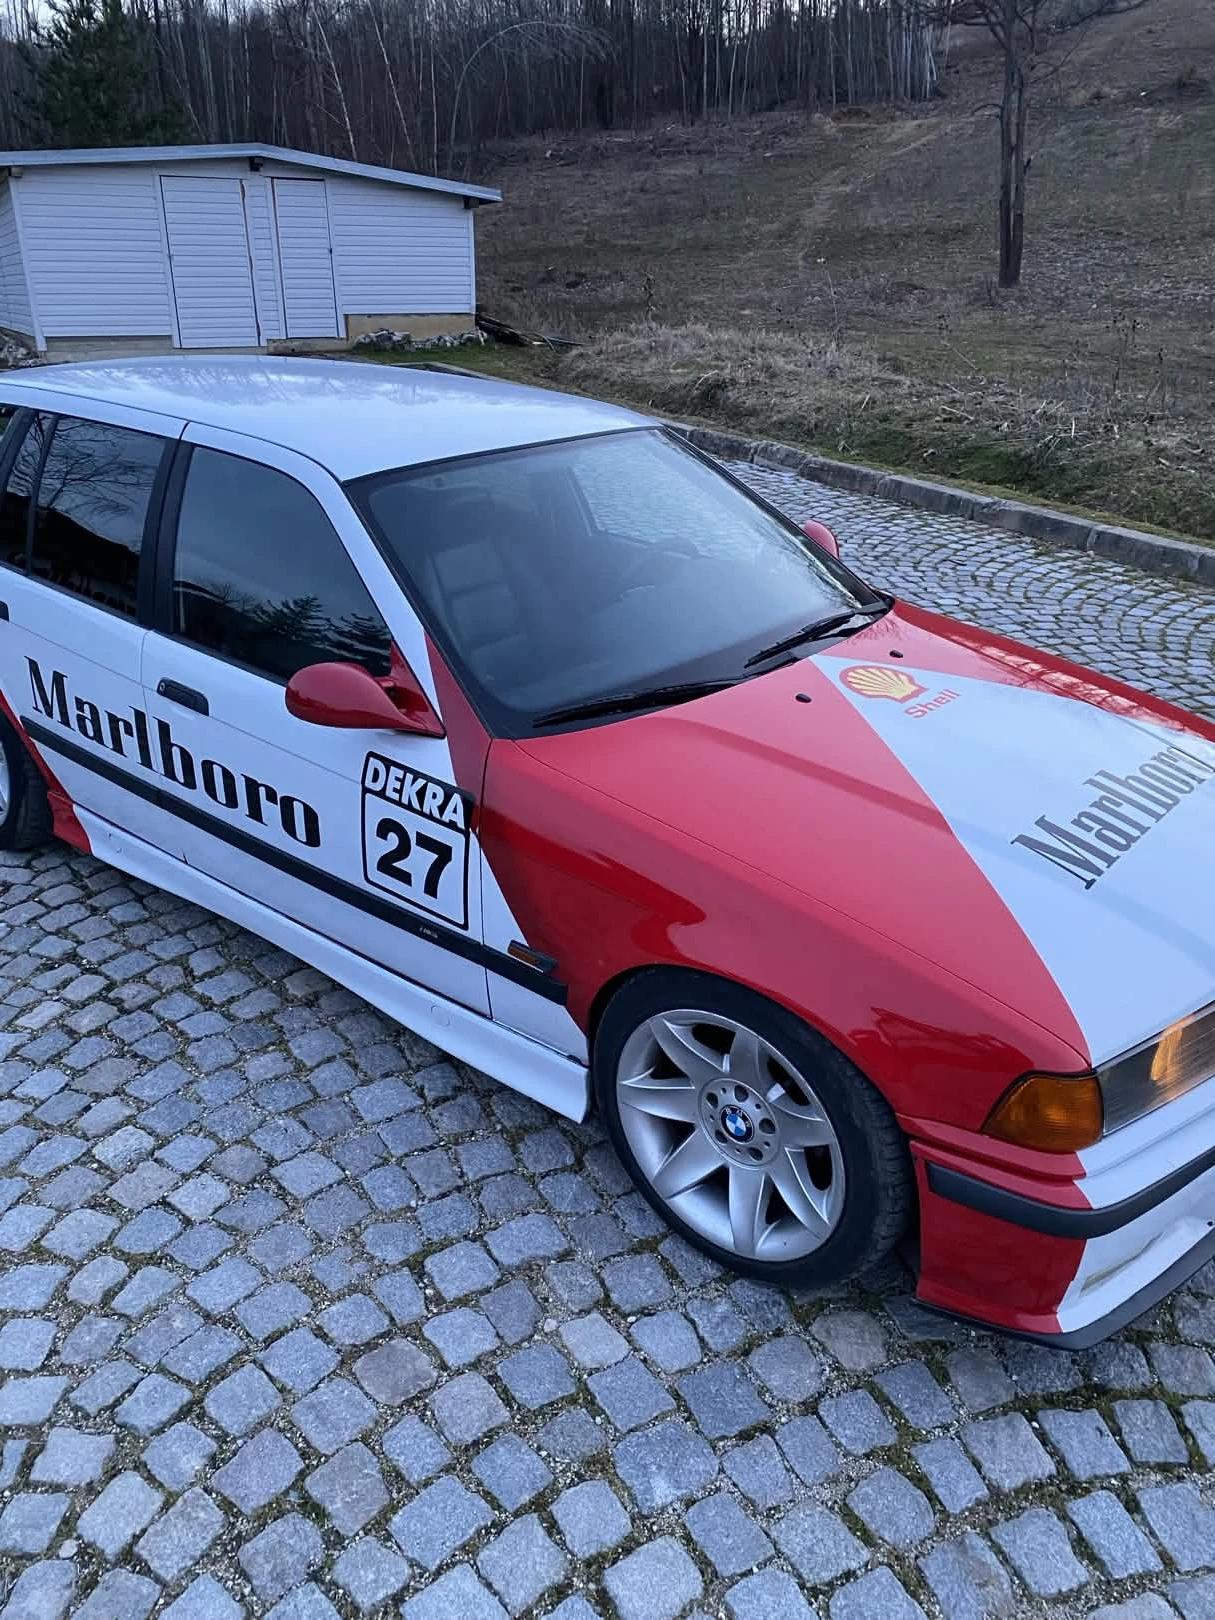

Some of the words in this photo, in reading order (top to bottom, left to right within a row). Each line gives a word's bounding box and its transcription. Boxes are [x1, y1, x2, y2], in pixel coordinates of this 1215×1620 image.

[903, 688, 961, 718] Shell
[24, 655, 321, 848] Marlboro
[364, 756, 466, 831] DEKRA
[375, 817, 453, 900] 27
